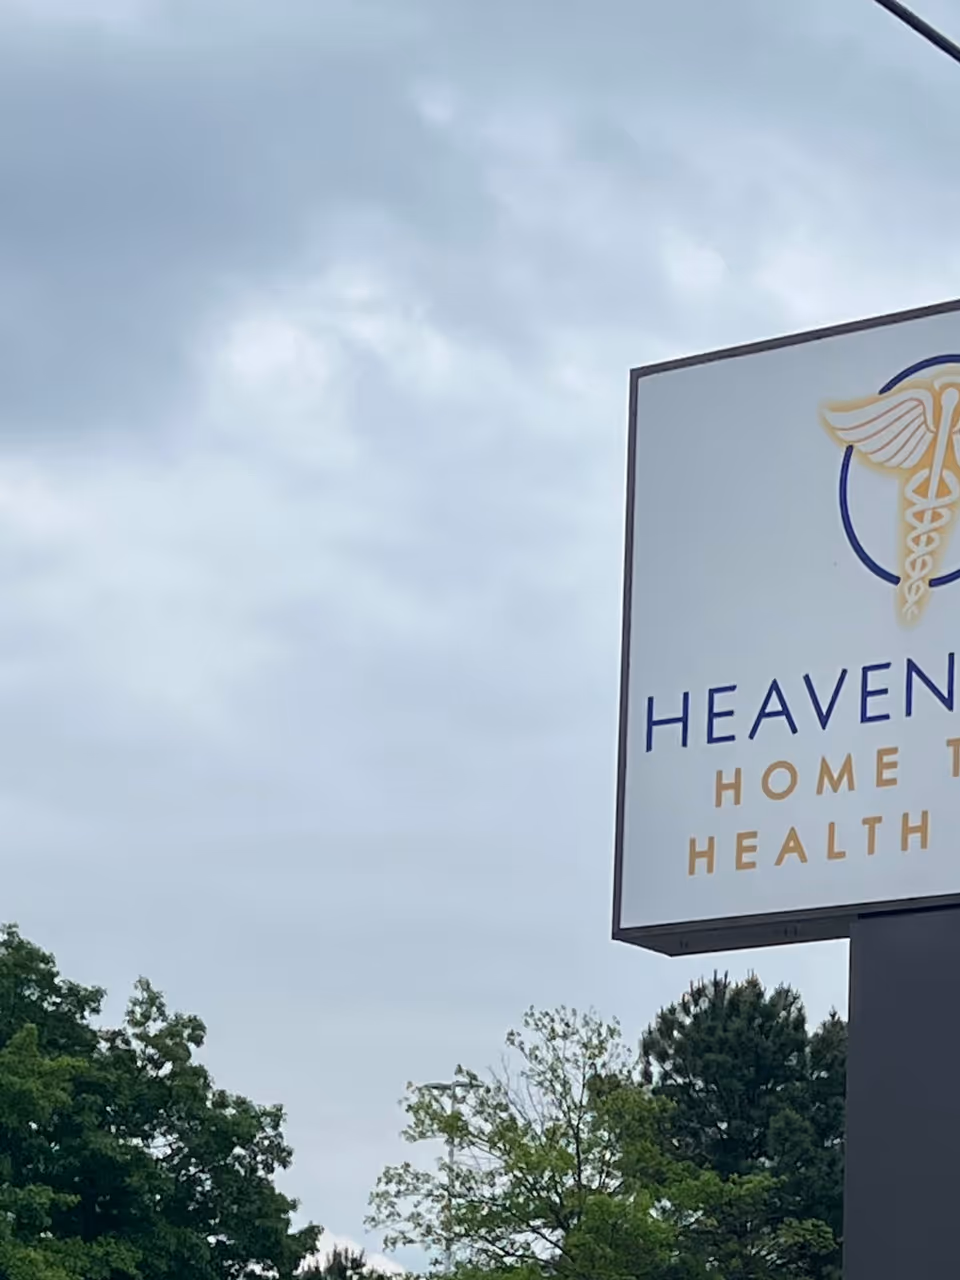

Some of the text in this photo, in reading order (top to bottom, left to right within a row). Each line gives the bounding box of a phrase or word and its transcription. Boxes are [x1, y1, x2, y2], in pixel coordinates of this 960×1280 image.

[645, 652, 956, 753] HEAVEN
[714, 746, 899, 807] HOME
[687, 810, 930, 876] HEALTH
